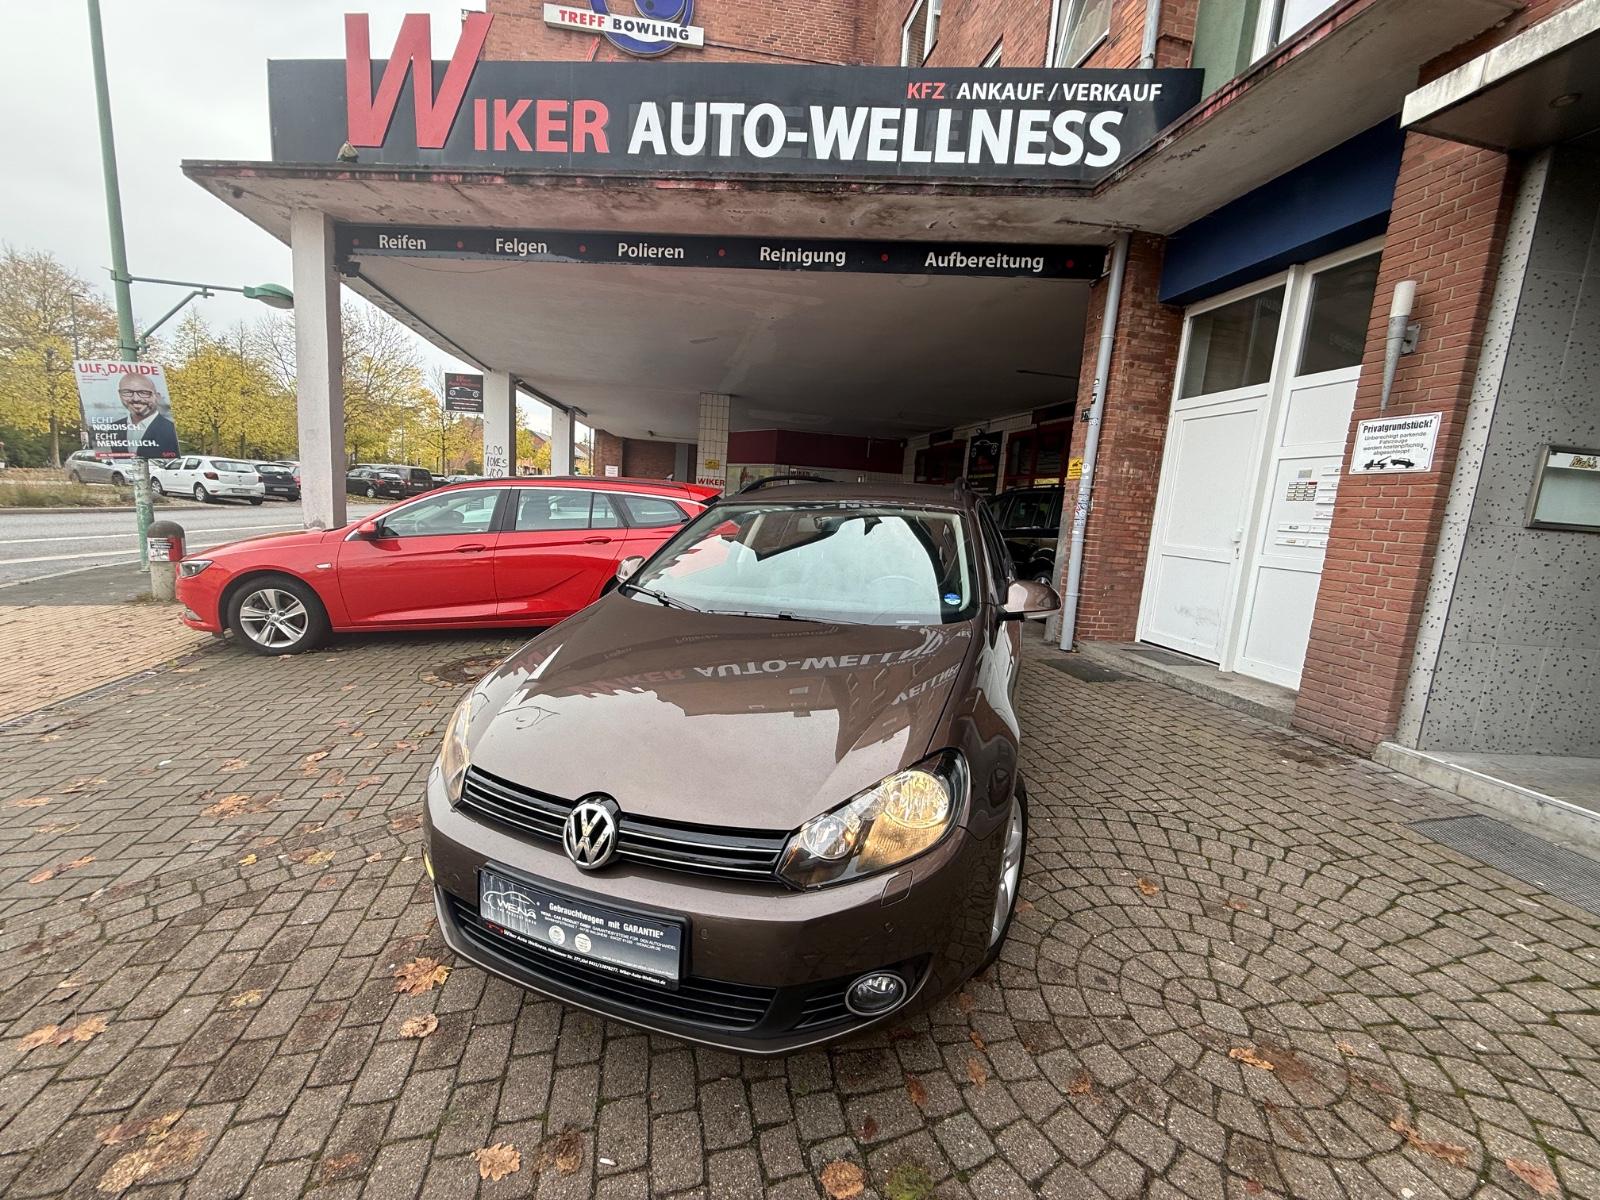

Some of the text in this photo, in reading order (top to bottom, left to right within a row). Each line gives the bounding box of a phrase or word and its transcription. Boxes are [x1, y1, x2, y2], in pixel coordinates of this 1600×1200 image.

[559, 9, 690, 41] TREFF BOWLING
[344, 13, 1124, 168] WIKER AUTO-WELLNESS
[906, 82, 945, 100] KFZ
[956, 82, 1045, 101] ANKAUF
[1062, 83, 1163, 102] VERKAUF
[378, 234, 1045, 273] Reifen Felgen Polieren Reinigung Aufbereitung
[78, 363, 160, 376] ULF DAUDE
[91, 416, 114, 424] ECHT
[93, 423, 144, 431] NORDISCH.
[1362, 419, 1433, 434] Privatgrundstück!
[95, 432, 118, 440] ECHT
[96, 439, 160, 448] MENSCHLICH.
[697, 478, 726, 487] WIKER
[549, 902, 605, 926] Gebrauchtwagen
[607, 920, 621, 930] mit
